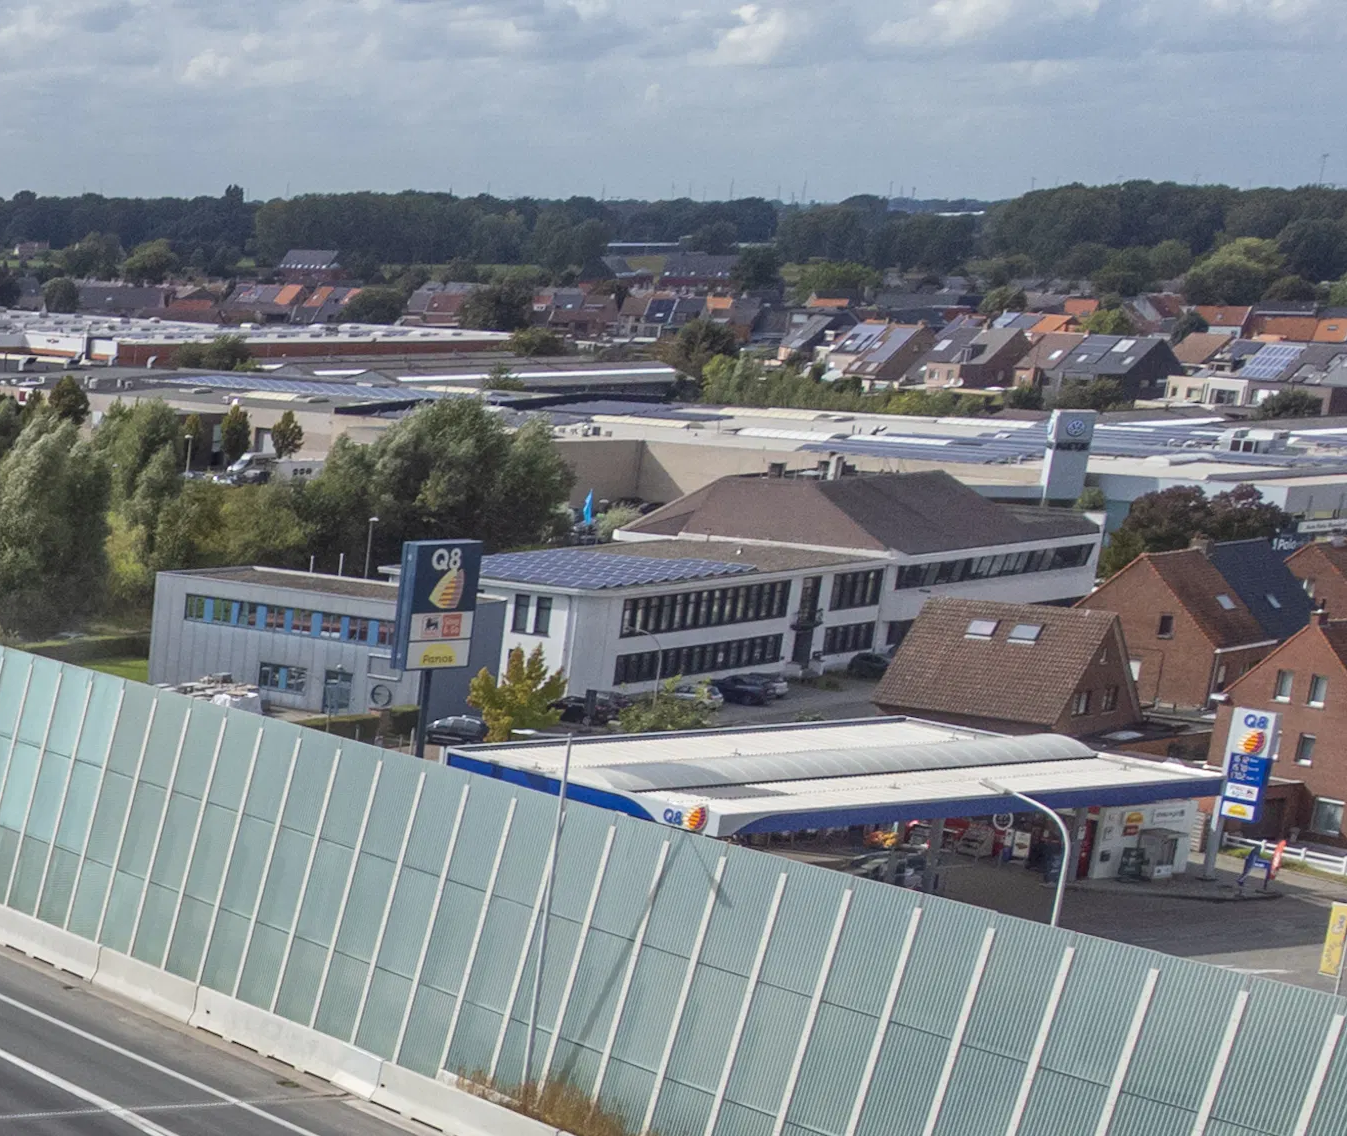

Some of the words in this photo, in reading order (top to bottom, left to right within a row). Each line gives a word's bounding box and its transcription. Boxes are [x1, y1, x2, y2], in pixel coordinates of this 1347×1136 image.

[432, 548, 462, 570] Q8
[1244, 714, 1269, 729] Q8
[663, 808, 683, 826] Q8
